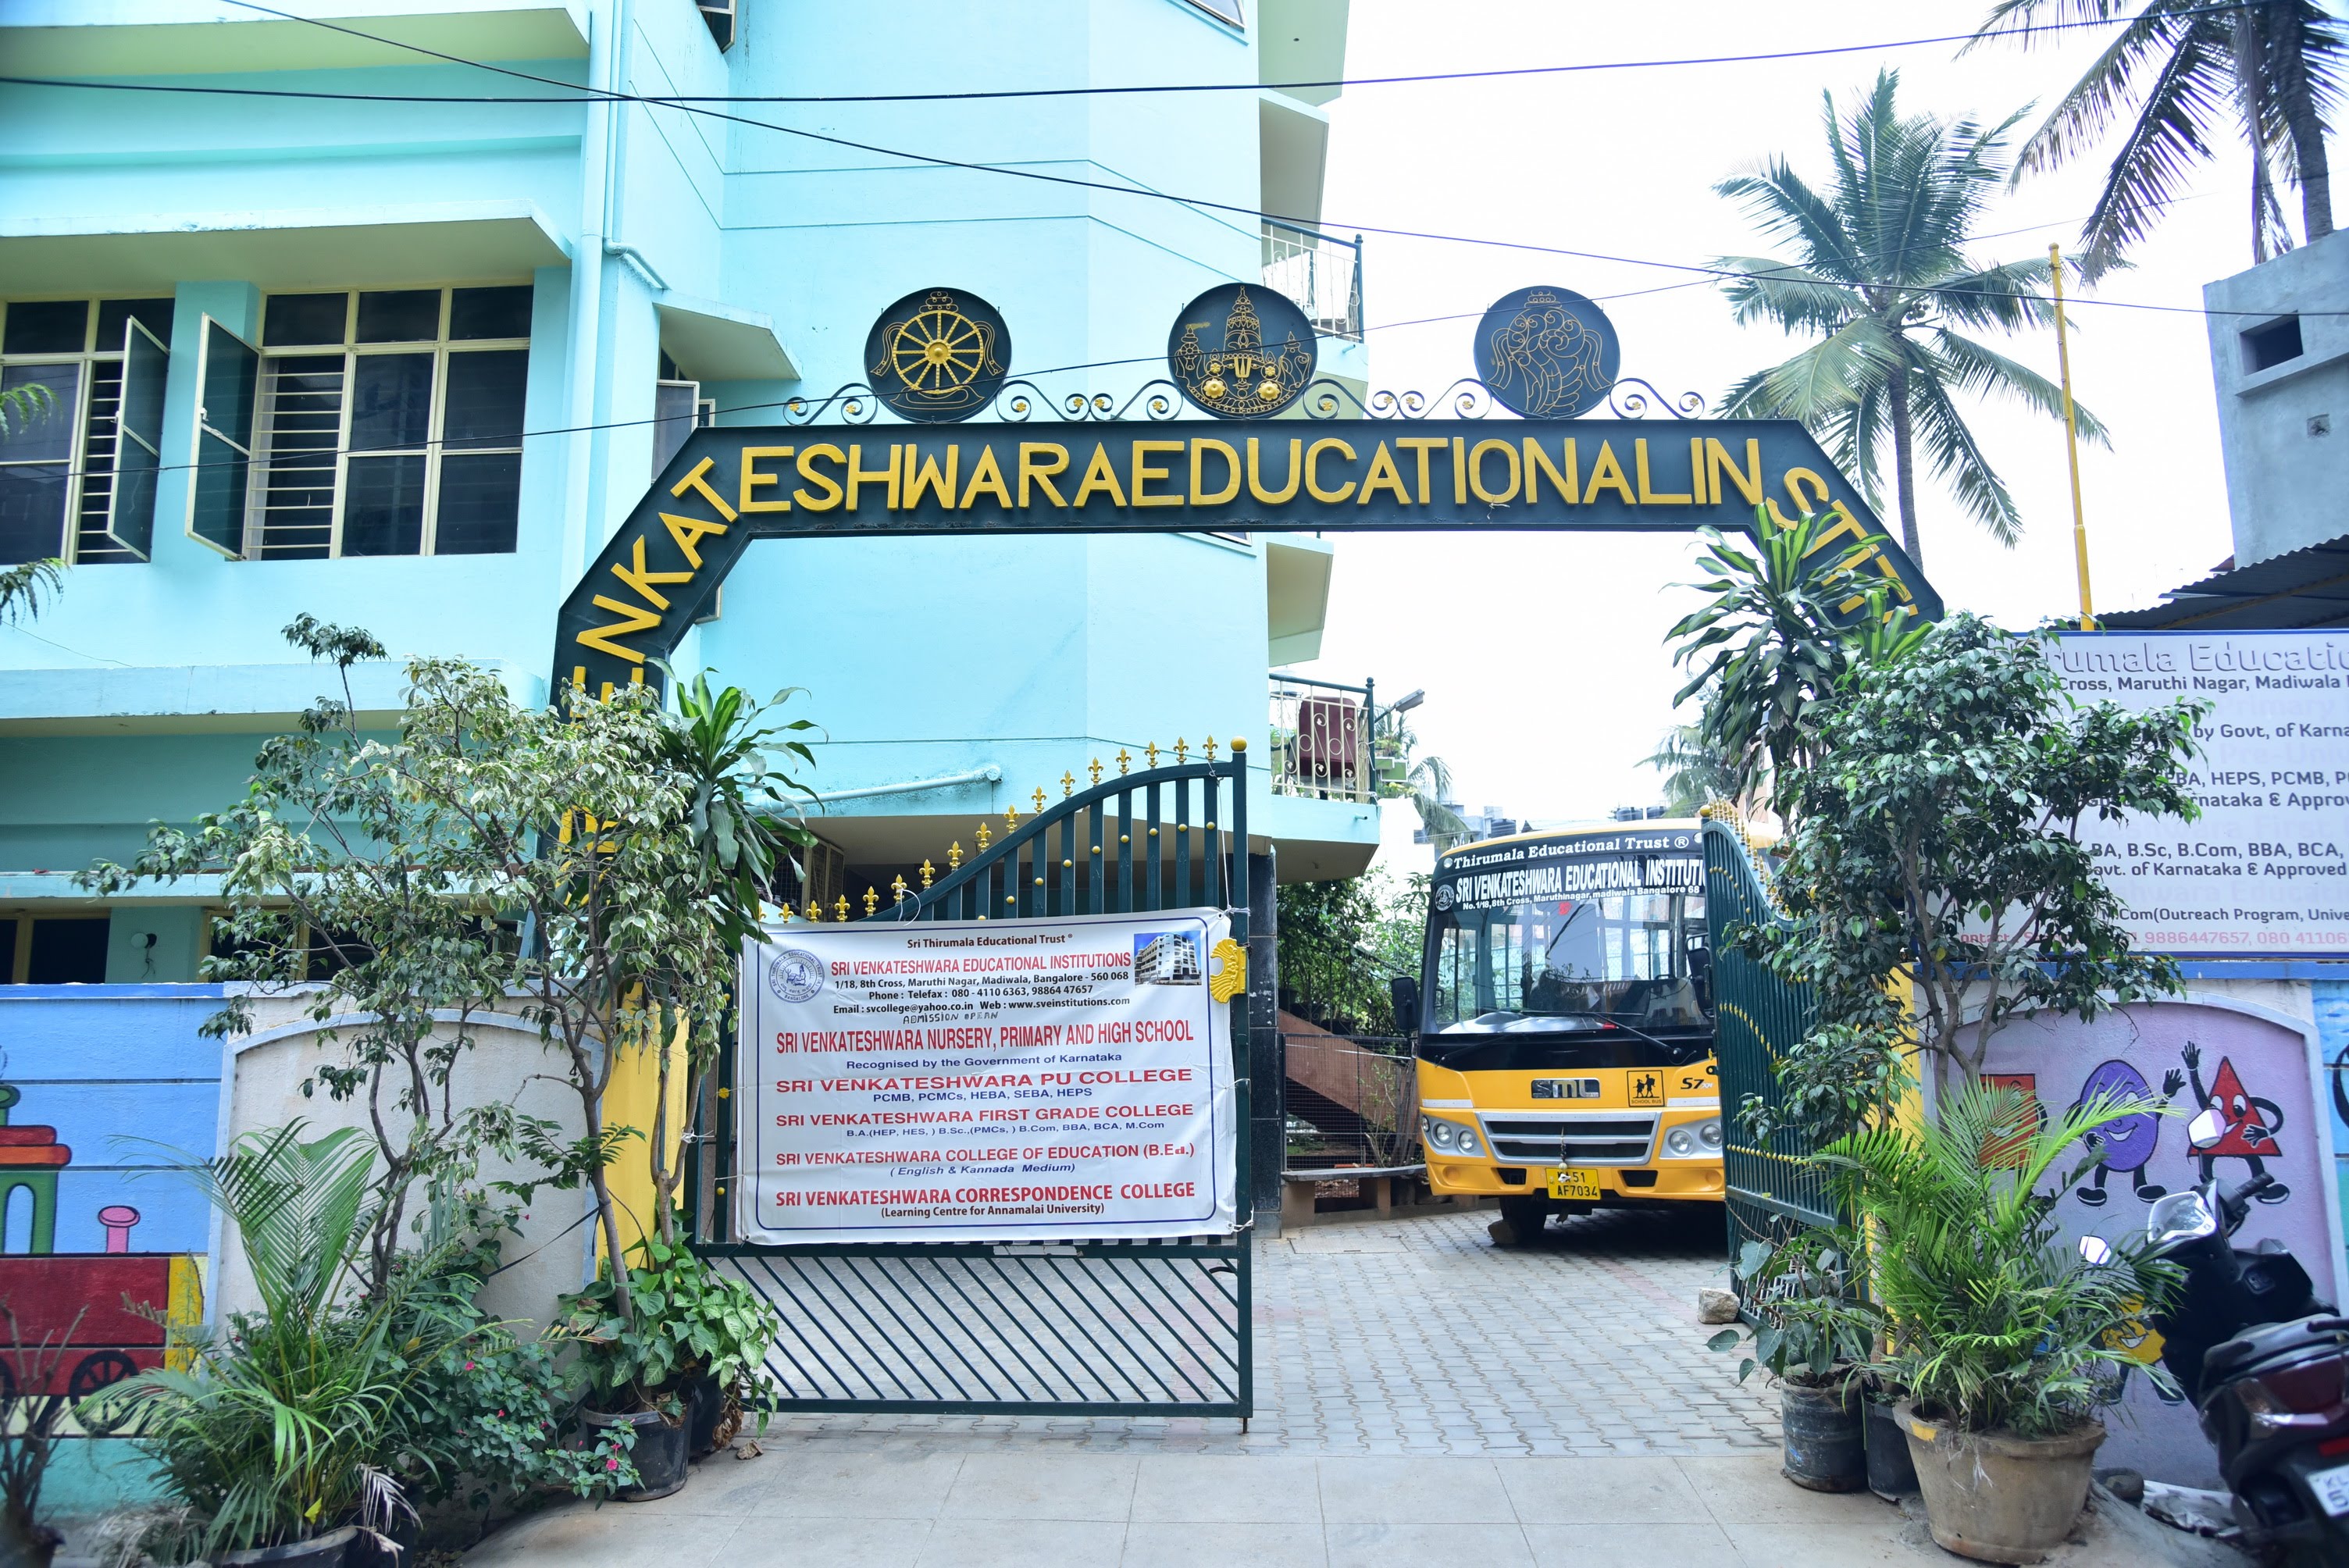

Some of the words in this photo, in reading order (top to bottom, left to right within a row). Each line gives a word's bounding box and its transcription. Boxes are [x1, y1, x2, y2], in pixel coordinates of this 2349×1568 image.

[2117, 675, 2187, 690] Maruthi
[2193, 676, 2250, 693] Nagar,
[2255, 674, 2340, 690] Madiwala
[2194, 724, 2215, 742] by
[2220, 723, 2270, 739] Govt,
[2276, 722, 2296, 738] of
[2211, 772, 2265, 787] HEPS,
[2271, 771, 2329, 787] PCMB,
[2335, 771, 2349, 785] P
[2187, 792, 2263, 807] rnataka
[2269, 792, 2282, 807] &
[1453, 847, 1524, 869] Thirumala
[1528, 839, 1620, 858] Educational
[1624, 836, 1670, 850] Trust
[2127, 843, 2172, 860] B.Sc,
[2177, 843, 2242, 859] B.Com,
[2248, 843, 2292, 859] BBA,
[2298, 843, 2344, 859] BCA,
[2088, 864, 2126, 875] ovt.
[2131, 862, 2149, 875] of
[2154, 862, 2241, 875] Karnataka
[2247, 862, 2258, 875] &
[2264, 861, 2347, 880] Approved
[1456, 877, 1473, 903] SRI
[1474, 866, 1563, 900] VENKATESHWARA
[1565, 861, 1641, 892] EDUCATIONAL
[1506, 896, 1532, 906] Cross,
[1637, 885, 1686, 896] Bangalore
[1688, 885, 1700, 894] 68
[2234, 907, 2304, 924] Program,
[907, 939, 921, 949] Sri
[923, 938, 975, 947] Thirumala
[977, 935, 1036, 946] Educational
[1039, 934, 1065, 943] Trust
[2144, 932, 2252, 946] 9886447657,
[2257, 932, 2290, 944] 080
[2295, 932, 2349, 944] 41106
[831, 961, 850, 976] SRI
[854, 958, 960, 975] VENKATESHWARA
[963, 954, 1046, 973] EDUCATIONAL
[1050, 952, 1131, 969] INSTITUTIONS
[835, 981, 857, 989] 1/18,
[860, 979, 876, 988] 8th
[878, 979, 906, 989] Cross,
[907, 978, 946, 986] Maruthi
[948, 977, 980, 989] Nagar,
[982, 975, 1031, 985] Madiwala,
[1033, 973, 1083, 985] Bangalore
[1091, 972, 1108, 982] 560
[1110, 971, 1129, 980] 068
[869, 992, 899, 1000] Phone
[907, 990, 943, 999] Telefax
[951, 989, 970, 998] 080
[977, 988, 1001, 996] 4110
[1002, 986, 1029, 997] 6363,
[1032, 985, 1061, 995] 98864
[1063, 985, 1093, 994] 47657
[833, 1005, 859, 1014] Email
[866, 1001, 974, 1014] svcollege@yahoo.co.in
[1008, 996, 1130, 1009] www.sveinstitutions.com
[776, 1032, 797, 1053] SRI
[802, 1029, 923, 1053] VENKATESHWARA
[928, 1027, 996, 1052] NURSERY,
[1000, 1025, 1062, 1047] PRIMARY
[1066, 1024, 1094, 1045] AND
[1098, 1021, 1132, 1043] HIGH
[1135, 1019, 1194, 1042] SCHOOL
[847, 1060, 918, 1070] Recognised
[922, 1059, 937, 1069] by
[941, 1058, 961, 1067] the
[964, 1056, 1039, 1067] Government
[1044, 1055, 1055, 1064] of
[1060, 1053, 1122, 1063] Karnataka
[776, 1080, 813, 1093] SRI
[820, 1074, 1033, 1092] VENKATESHWARA
[1040, 1072, 1071, 1085] PU
[1078, 1068, 1192, 1085] COLLEGE
[873, 1092, 914, 1103] PCMB,
[918, 1092, 967, 1102] PCMCs,
[970, 1090, 1011, 1100] HEBA,
[1014, 1089, 1053, 1099] SEBA,
[1057, 1088, 1093, 1097] HEPS
[776, 1114, 804, 1126] SRI
[810, 1110, 973, 1125] VENKATESHWARA
[979, 1109, 1030, 1121] FIRST
[1035, 1107, 1100, 1121] GRADE
[1105, 1103, 1193, 1118] COLLEGE
[847, 1129, 900, 1138] B.A.(HEP,
[903, 1128, 929, 1137] HES,
[1019, 1124, 1059, 1133] B.Com,
[1094, 1122, 1122, 1131] BCA,
[776, 1153, 800, 1165] SRI
[805, 1150, 941, 1164] VENKATESHWARA
[946, 1148, 1018, 1162] COLLEGE
[1022, 1147, 1043, 1160] OF
[1048, 1145, 1139, 1159] EDUCATION
[1143, 1142, 1194, 1159] (B.Ed.)
[898, 1167, 943, 1177] English
[961, 1164, 1014, 1174] Kannada
[1022, 1164, 1075, 1173] Medium)
[776, 1192, 800, 1206] SRI
[806, 1188, 951, 1206] VENKATESHWARA
[956, 1185, 1112, 1203] CORRESPONDENCE
[1121, 1181, 1195, 1199] COLLEGE
[1558, 1185, 1598, 1196] AF7034
[882, 1207, 930, 1218] (Learning
[933, 1206, 967, 1216] Centre
[970, 1205, 985, 1215] for
[988, 1204, 1044, 1214] Annamalai
[1047, 1203, 1104, 1214] University)
